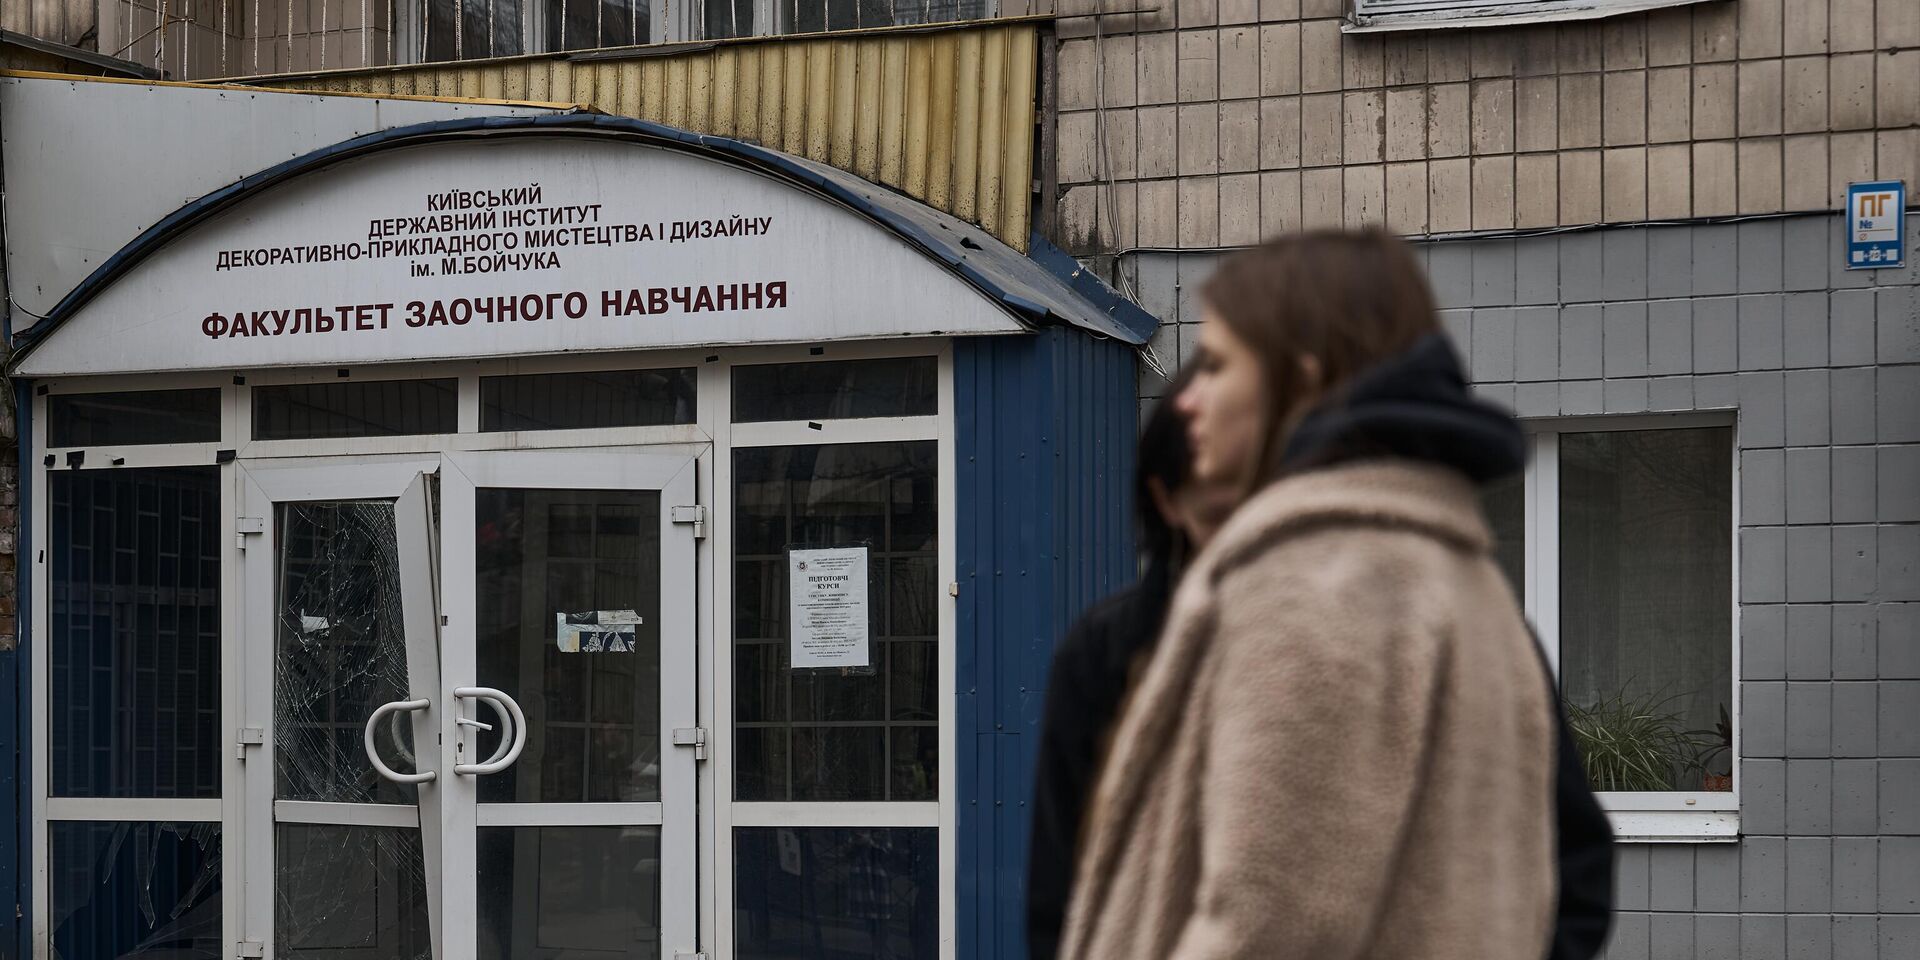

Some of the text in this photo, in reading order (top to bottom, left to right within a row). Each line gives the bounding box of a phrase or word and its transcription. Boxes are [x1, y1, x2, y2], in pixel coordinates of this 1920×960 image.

[427, 183, 542, 212] КИЇВСЬКИЙ
[1860, 194, 1891, 217] ПГ
[368, 204, 602, 240] ДЕРЖАВНИЙ ІНСТИТУТ
[216, 215, 772, 271] ДЕКОРАТИВНО-ПРИКЛАДНОГО МИСТЕЦТВА І ДИЗАЙНУ
[411, 250, 561, 277] ім. М.БОЙЧУКА
[202, 281, 787, 339] ФАКУЛЬТЕТ ЗАОЧНОГО НАВЧАННЯ
